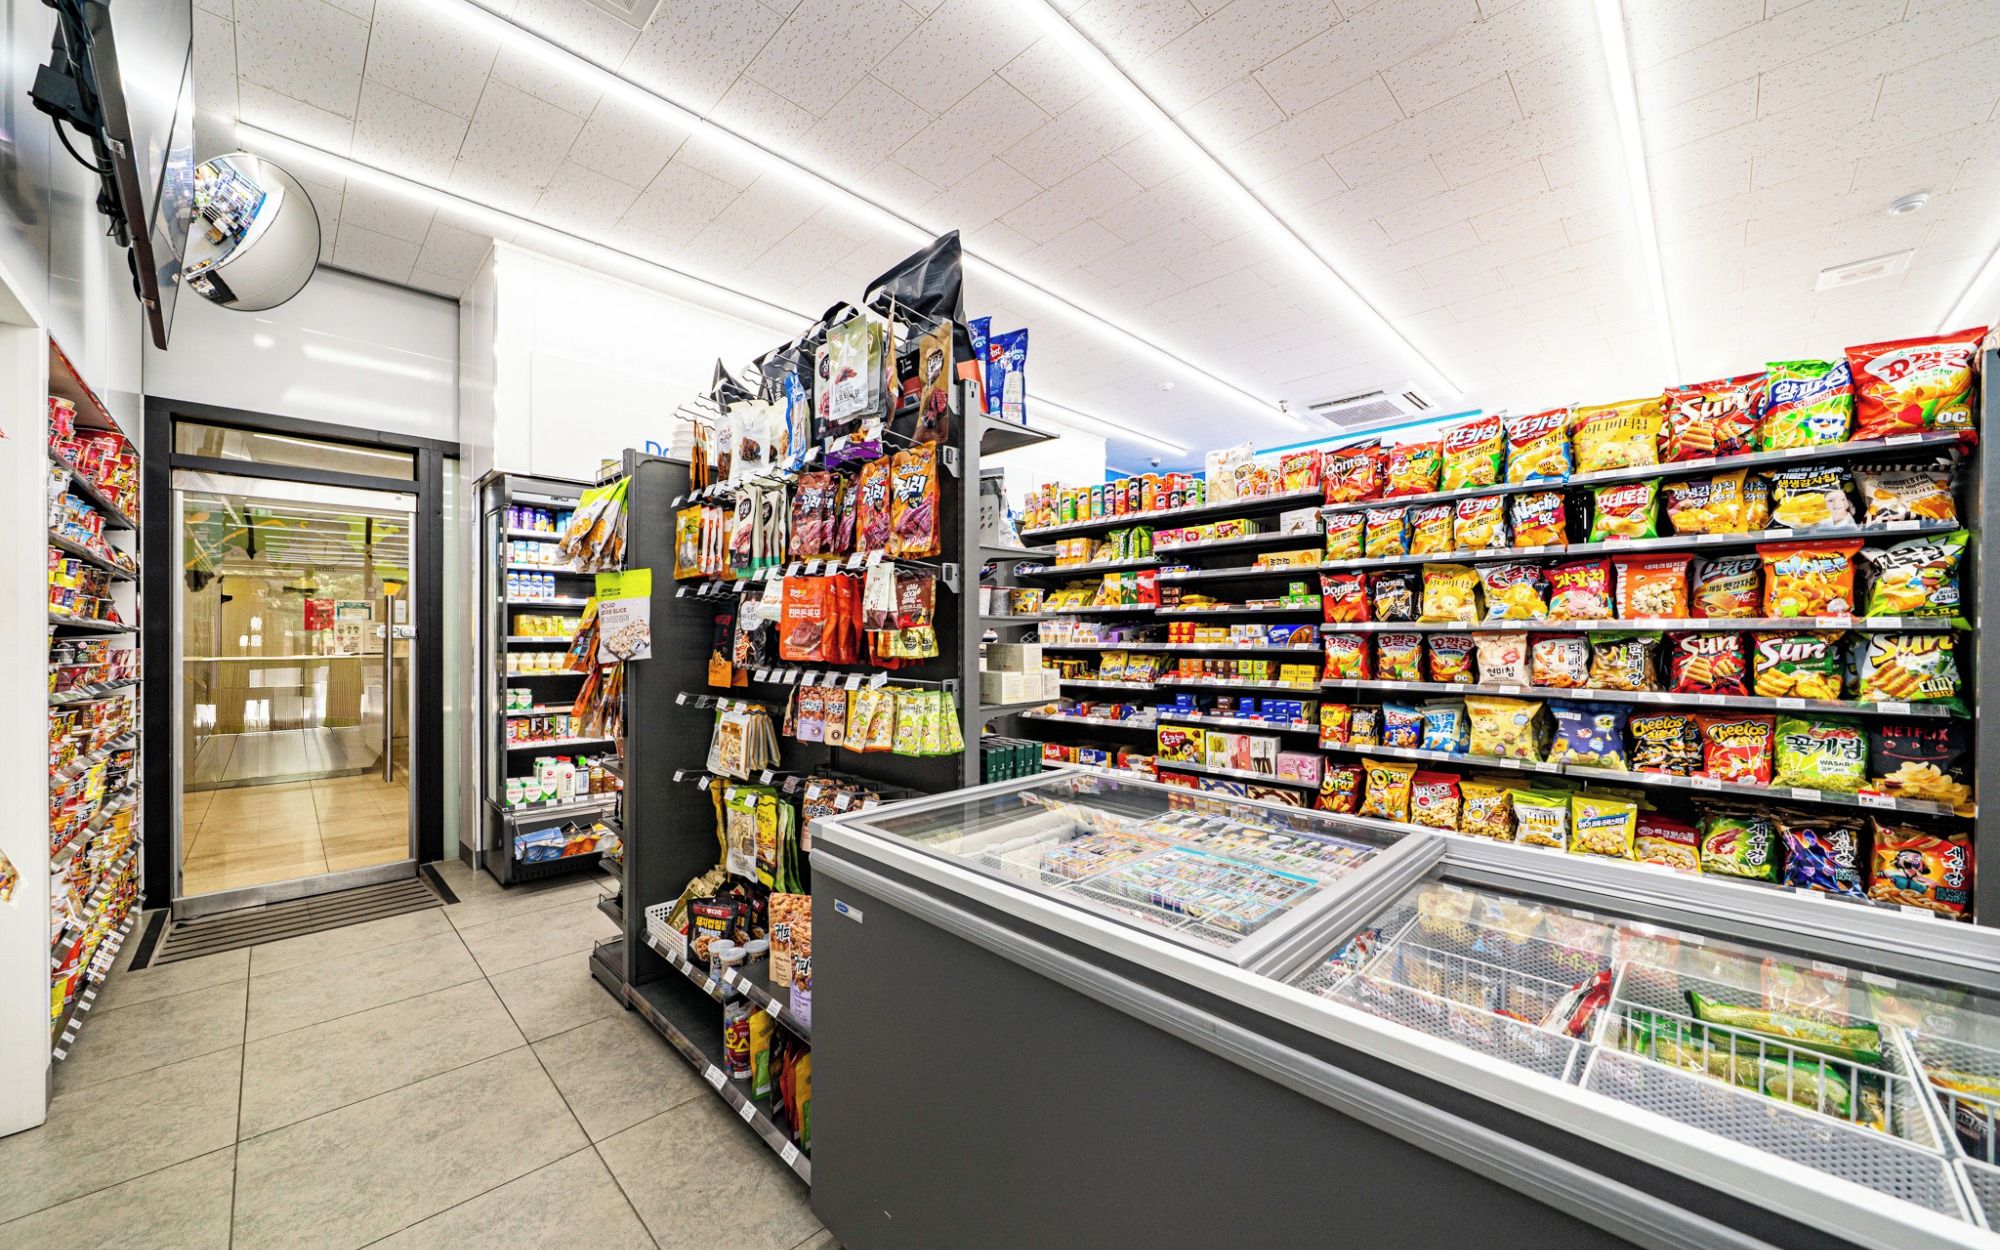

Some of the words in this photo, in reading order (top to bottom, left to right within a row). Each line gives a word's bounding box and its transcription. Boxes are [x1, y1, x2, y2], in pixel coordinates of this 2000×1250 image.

[1584, 418, 1648, 435] 허니버터칩
[1936, 410, 1966, 424] OC
[1448, 424, 1498, 447] 포카칩
[1510, 413, 1566, 441] 포카칩
[893, 476, 927, 502] 질러
[1779, 474, 1837, 488] 생생감자칩
[863, 484, 885, 505] 질러
[1460, 498, 1499, 514] 포카칩
[1323, 582, 1360, 597] Doritos
[1379, 634, 1419, 648] 꼬깔콘
[1431, 636, 1473, 650] 꼬깔콘
[1757, 639, 1827, 672] Sun
[1486, 667, 1515, 678] 현미칩
[1632, 715, 1684, 738] Cheetos
[1708, 721, 1769, 744] Cheetos
[1882, 726, 1949, 741] NETFLIX
[1785, 735, 1866, 760] 꽃게랑
[1749, 823, 1768, 866] 새우깡
